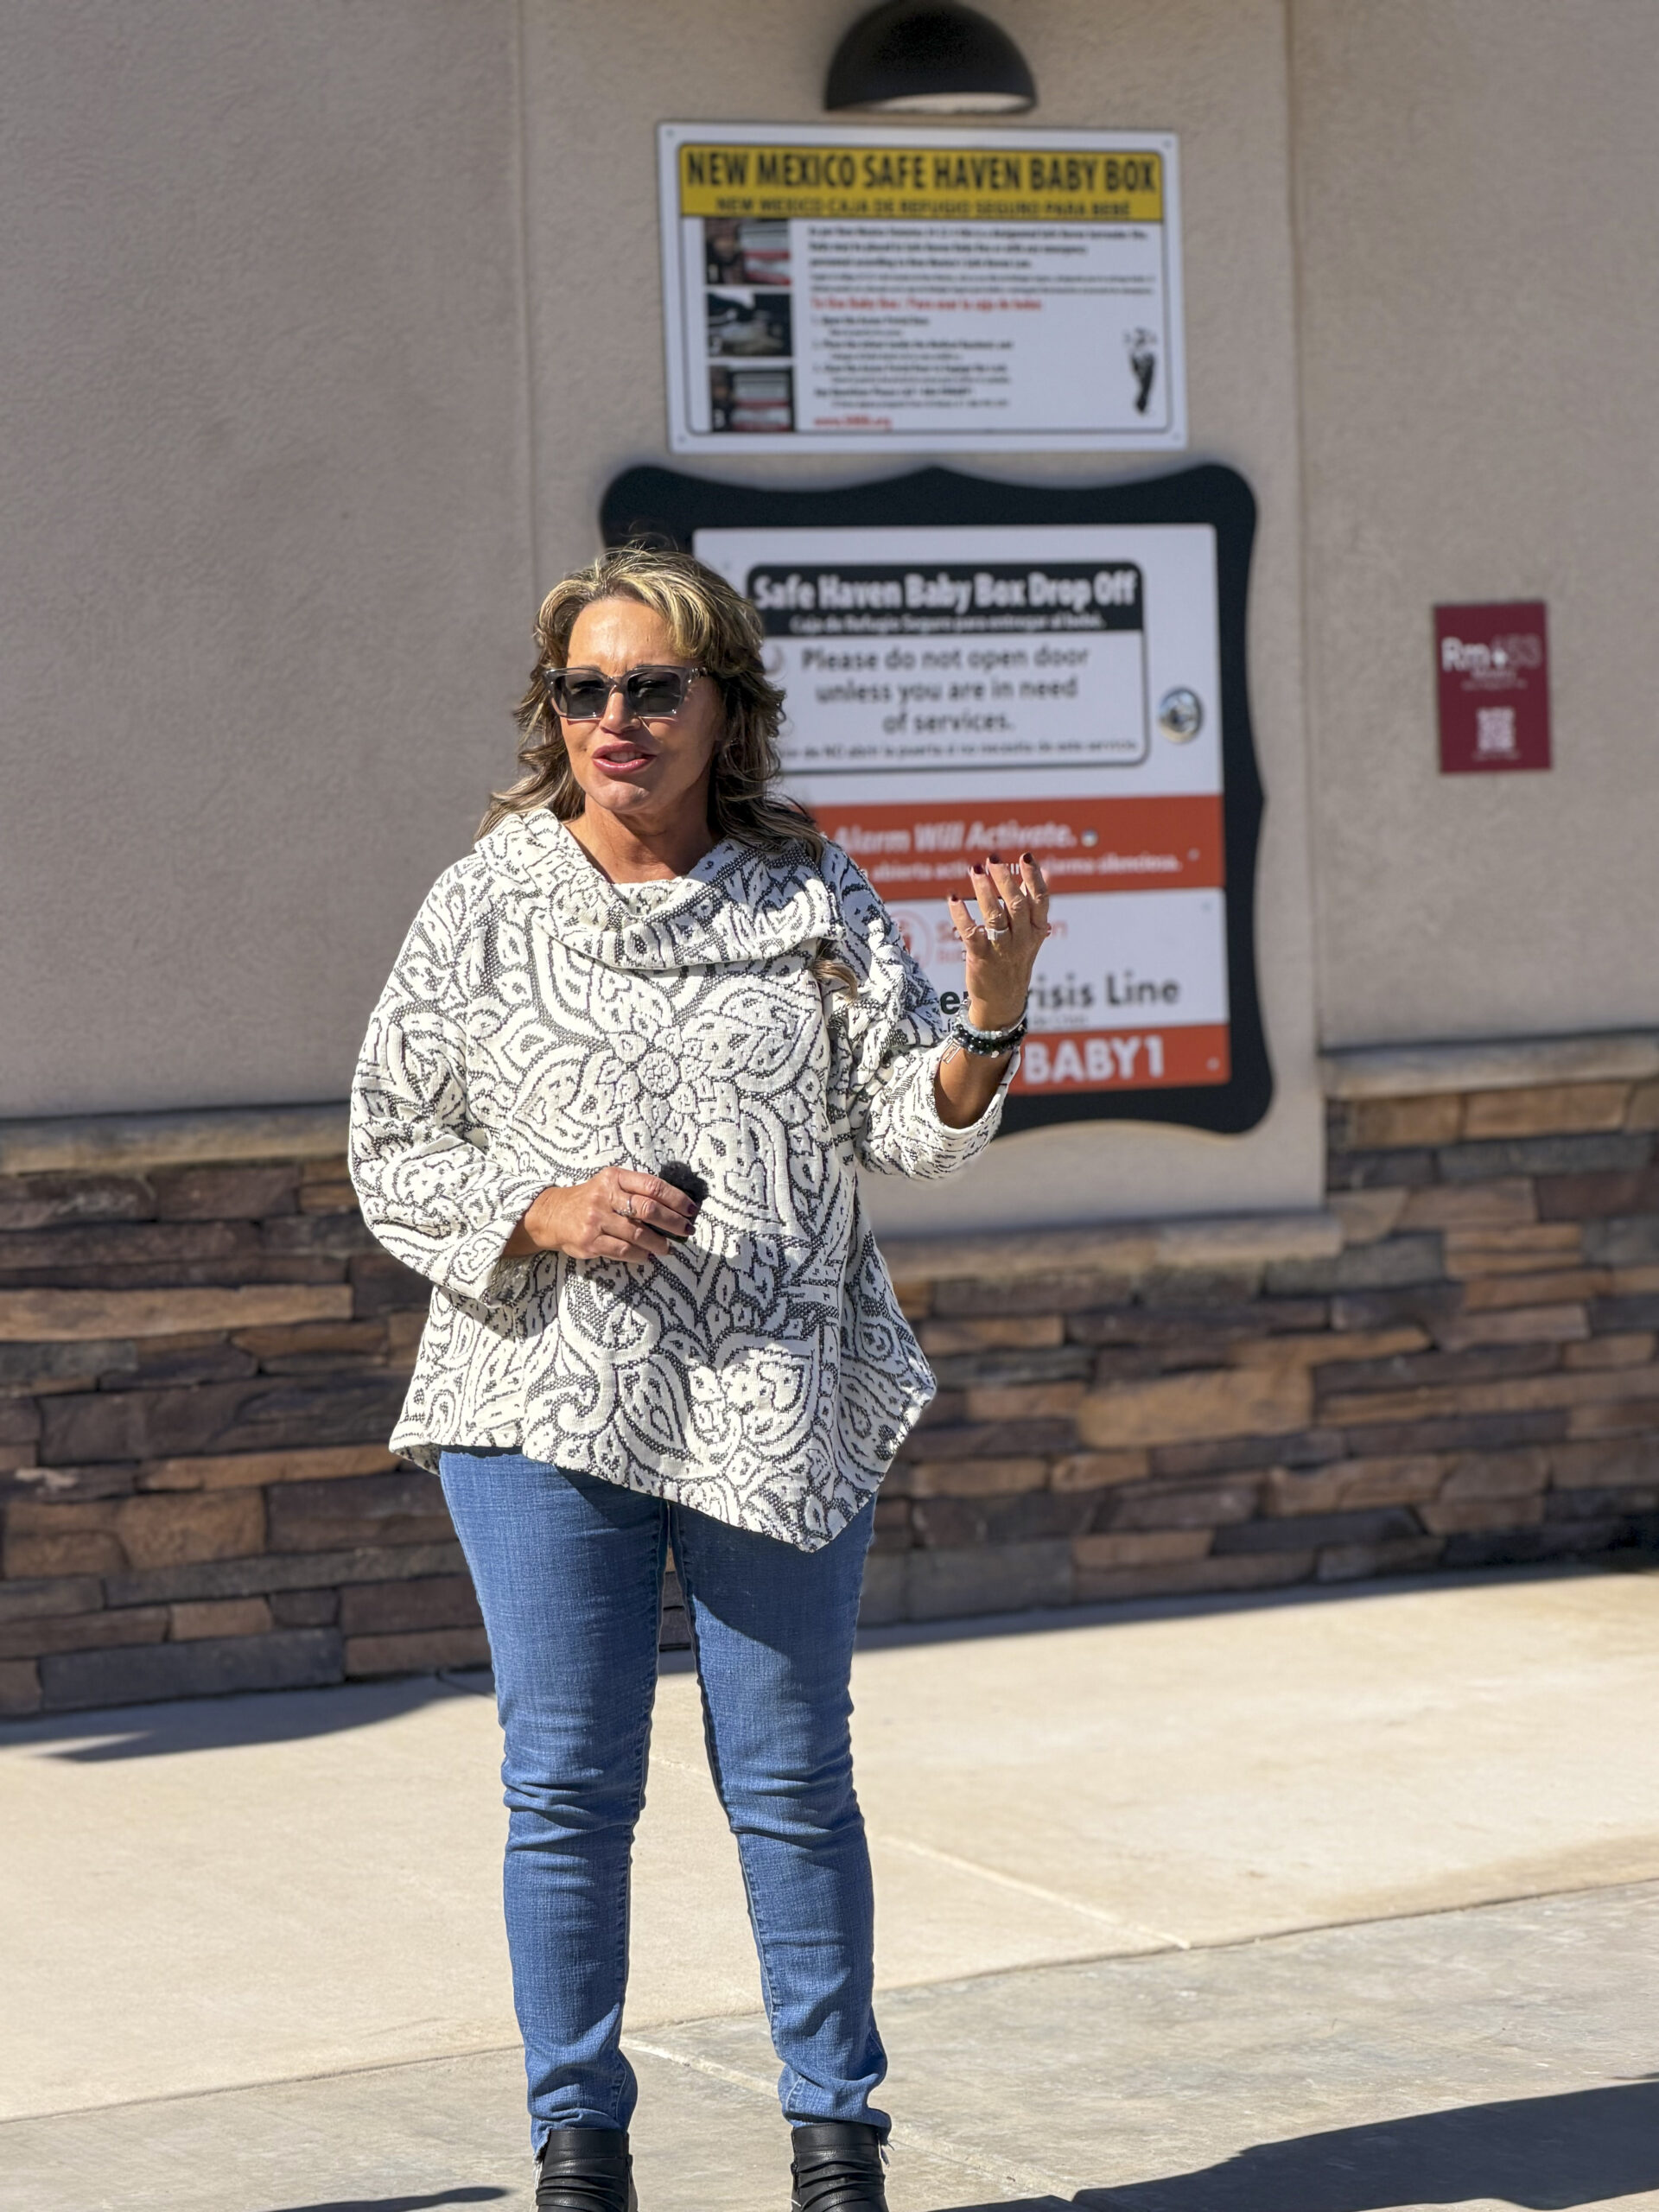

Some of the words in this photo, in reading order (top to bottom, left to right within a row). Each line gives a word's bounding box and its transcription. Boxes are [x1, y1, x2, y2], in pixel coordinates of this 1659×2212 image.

[687, 151, 749, 187] NEW
[757, 153, 855, 188] MEXICO
[862, 154, 925, 190] SAFE
[933, 156, 1021, 190] HAVEN
[1030, 157, 1097, 192] BABY
[1104, 159, 1156, 193] BOX
[754, 574, 816, 609] Safe
[818, 573, 902, 609] Haven
[905, 571, 973, 614] Baby
[974, 571, 1027, 607] Box
[1027, 570, 1092, 613] Drop
[1093, 569, 1138, 605] Off
[801, 646, 878, 671] Please
[885, 645, 916, 670] do
[921, 648, 961, 669] not
[968, 648, 1028, 674] open
[1034, 645, 1088, 666] door
[816, 677, 891, 704] unless
[897, 683, 942, 710] you
[948, 682, 985, 701] are
[990, 677, 1014, 698] in
[1020, 676, 1077, 698] need
[882, 711, 907, 734] of
[914, 709, 1015, 733] services.
[835, 824, 911, 854] Alarm
[913, 822, 965, 853] Will
[965, 818, 1078, 851] Activate.
[1027, 973, 1095, 1009] risis
[1105, 970, 1181, 1008] Line
